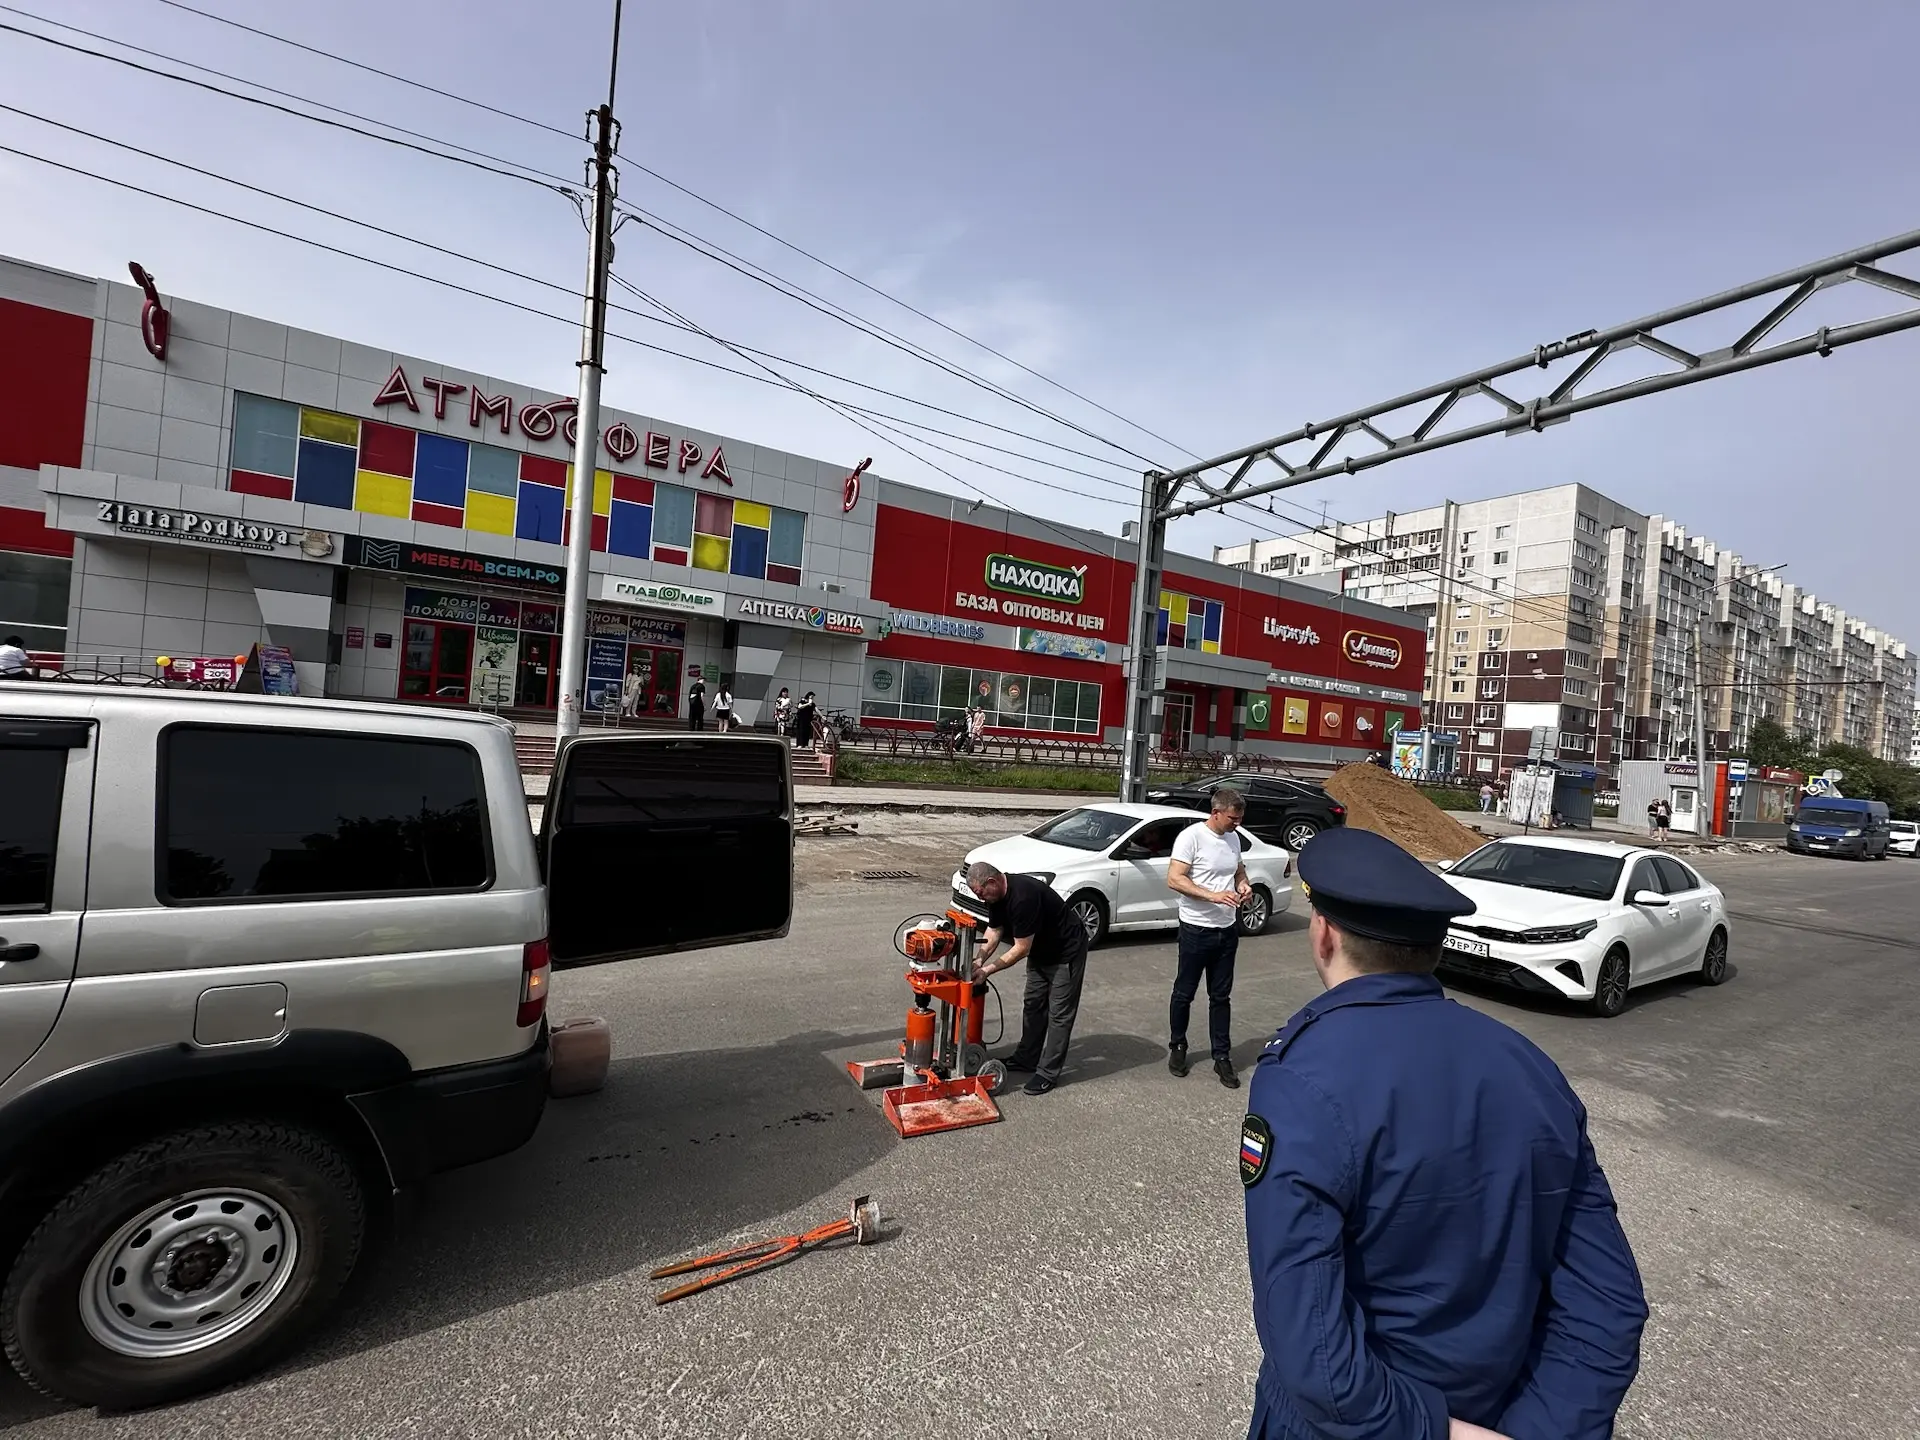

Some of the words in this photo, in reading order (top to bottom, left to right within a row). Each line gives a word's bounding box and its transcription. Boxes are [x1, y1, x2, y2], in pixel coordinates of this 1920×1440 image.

[97, 501, 171, 529] Zlata
[183, 513, 288, 545] Podkova
[411, 551, 560, 584] МЕБЕЛЬВСЕМ.РФ
[991, 561, 1080, 597] НАХОДКА
[411, 605, 518, 625] ПОЖАЛОВАТЬ!
[438, 597, 490, 610] ДОБРО
[739, 599, 807, 621] АПТЕКА
[826, 612, 864, 629] ВИТА
[955, 591, 998, 613] БАЗА
[1002, 600, 1074, 626] ОПТОВЫХ
[1076, 614, 1105, 631] ЦЕН
[631, 618, 677, 631] МАРКЕТ
[891, 612, 985, 640] WILDBERRIES
[1263, 616, 1320, 645] Циркуль
[1443, 937, 1470, 951] 29ЕР
